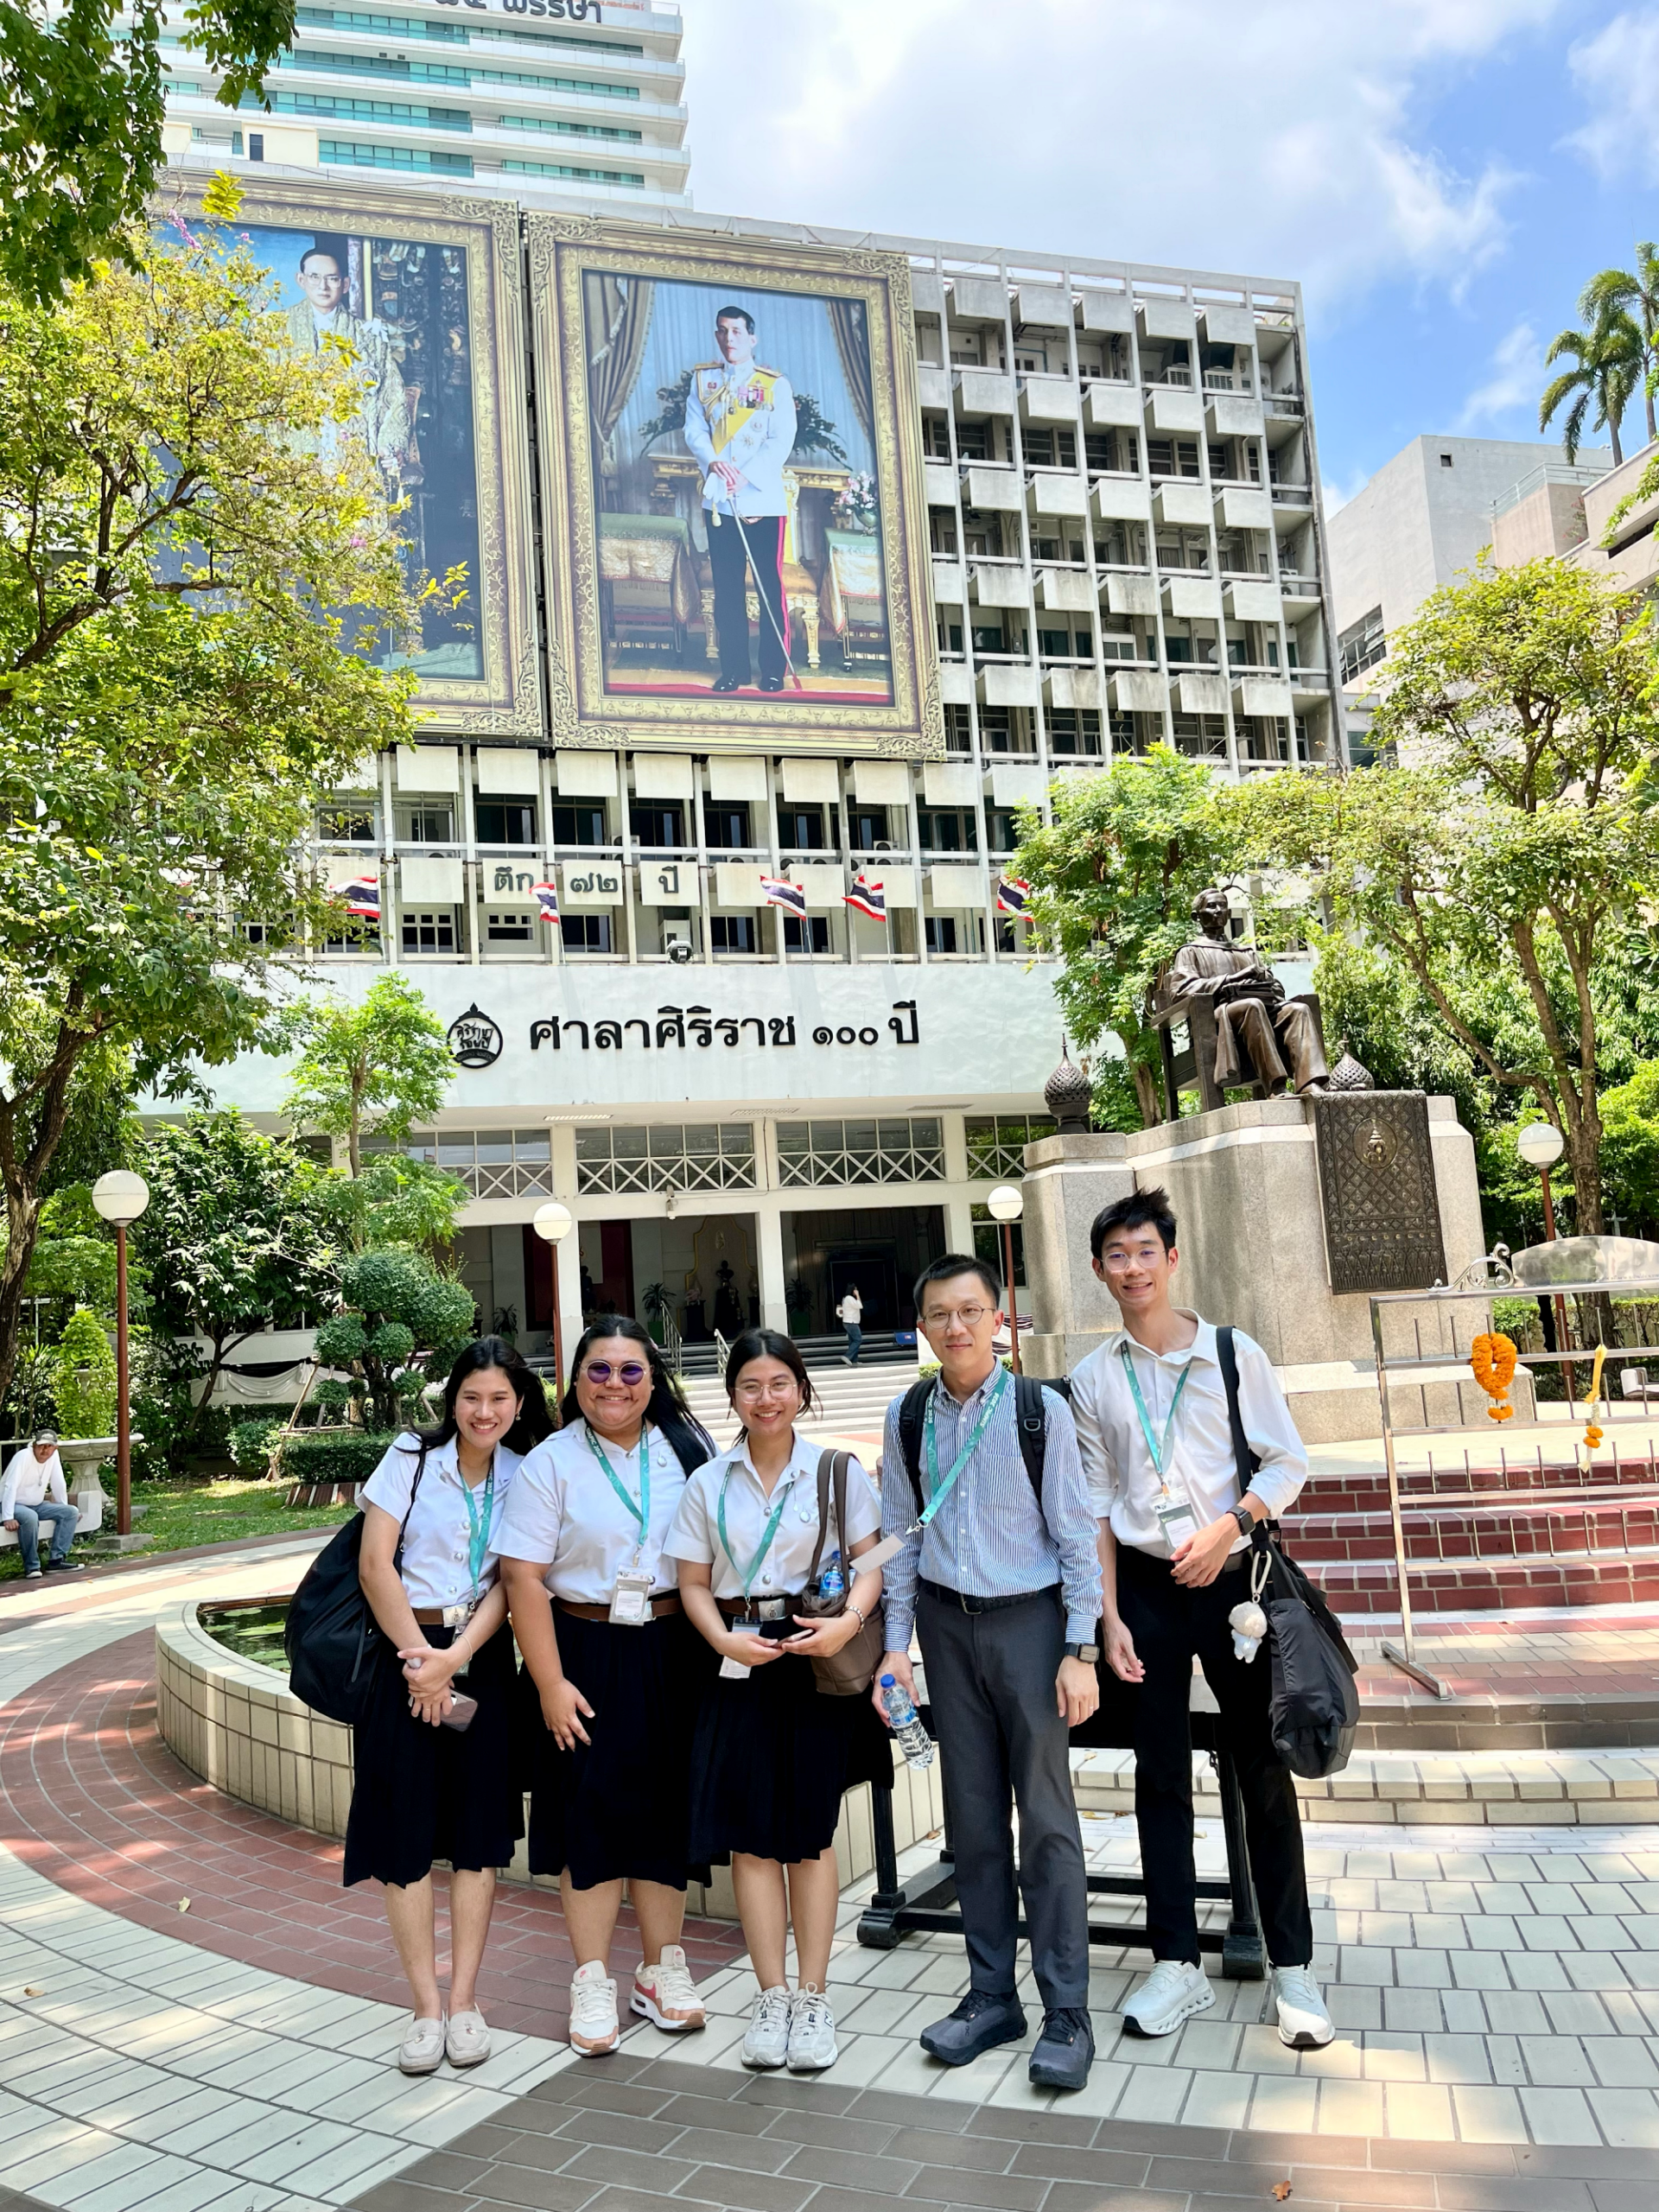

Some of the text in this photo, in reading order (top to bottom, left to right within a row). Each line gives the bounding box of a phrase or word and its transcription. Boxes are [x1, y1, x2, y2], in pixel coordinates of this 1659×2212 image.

[494, 865, 679, 893] ตึก ๗๒ ปี
[530, 1000, 919, 1050] ศาลาศิริราช ๑๐๐ ปี
[980, 1392, 1000, 1427] SIMPIC 2026
[586, 1427, 604, 1458] SIMPIC 2026
